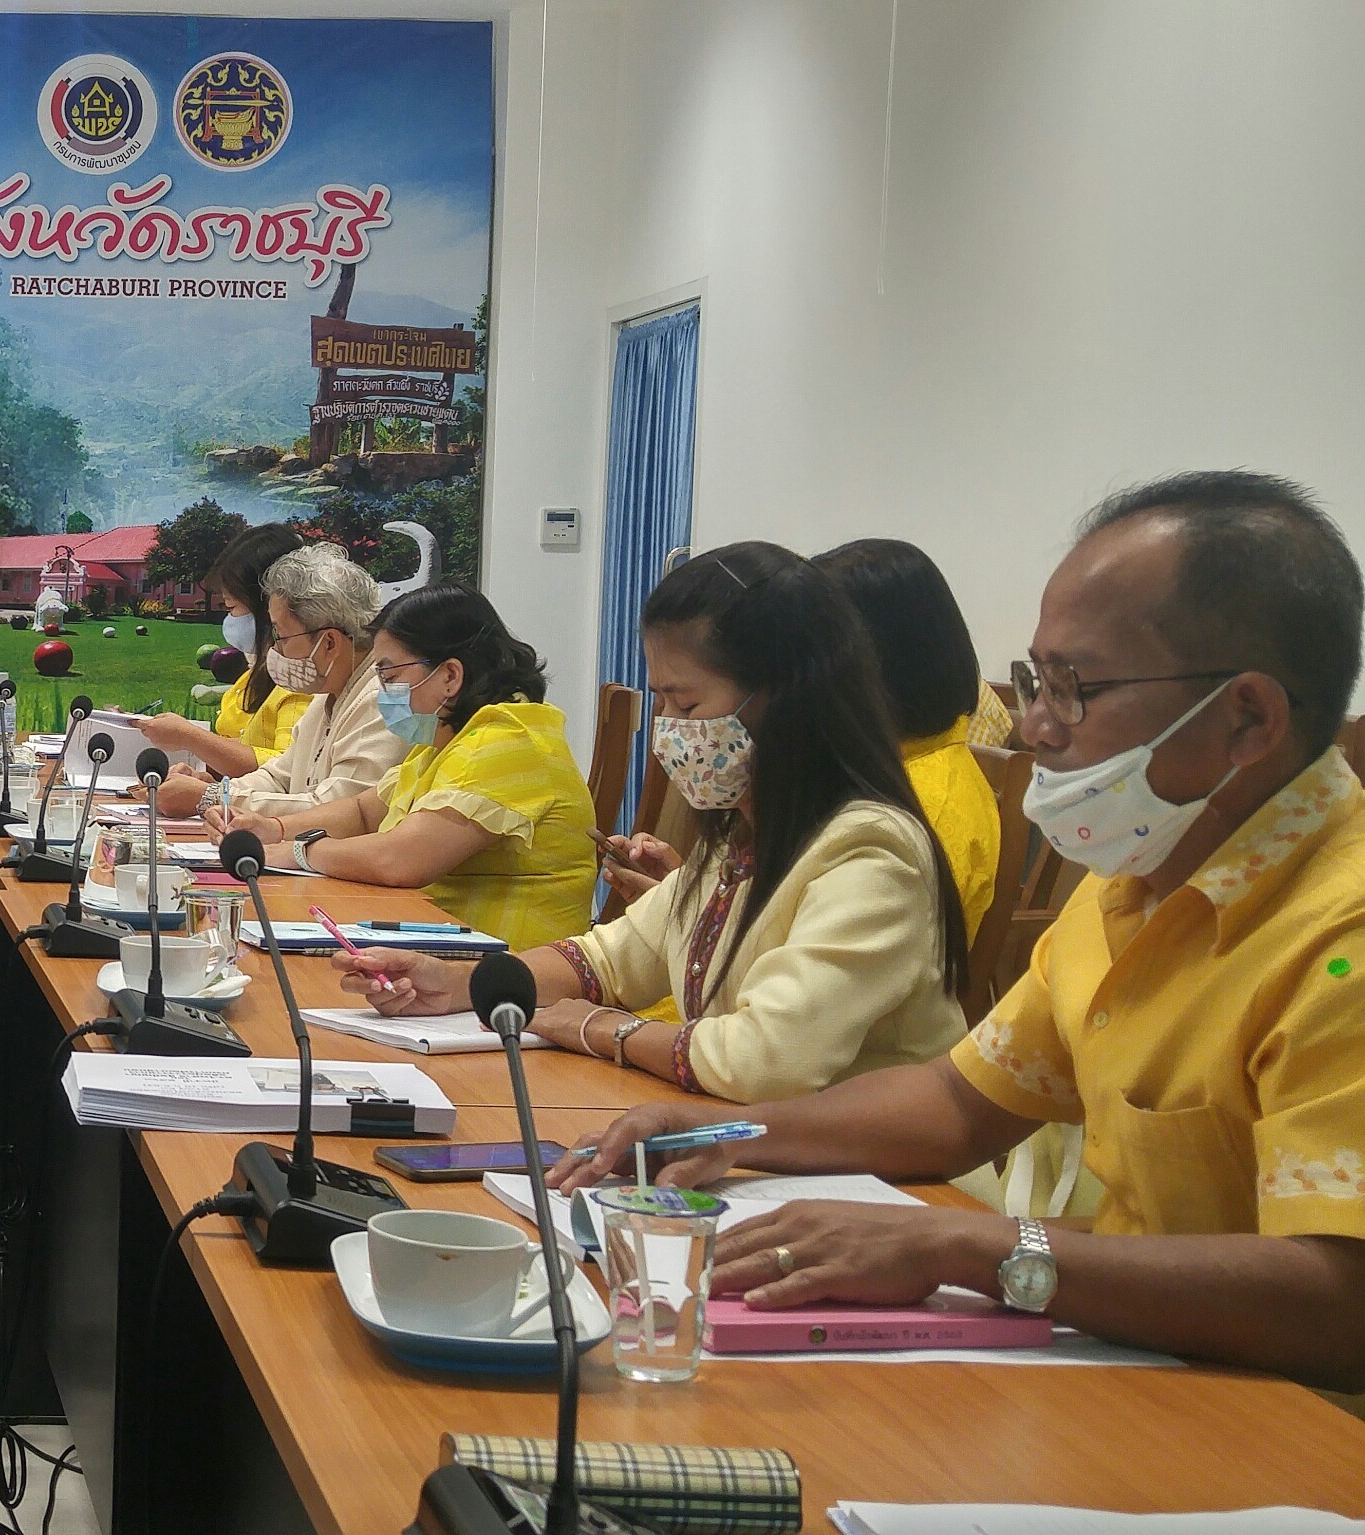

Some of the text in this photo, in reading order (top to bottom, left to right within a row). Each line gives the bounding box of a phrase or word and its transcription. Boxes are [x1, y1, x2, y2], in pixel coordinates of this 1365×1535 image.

[52, 139, 142, 170] กรมการพัฒนาชุมชน
[11, 276, 288, 301] RATCHABURI PROVINCE
[373, 328, 427, 343] เขากระโจม
[316, 336, 472, 369] สุดเขตประเทศไทย
[332, 377, 384, 392] ภาคตะวันตก
